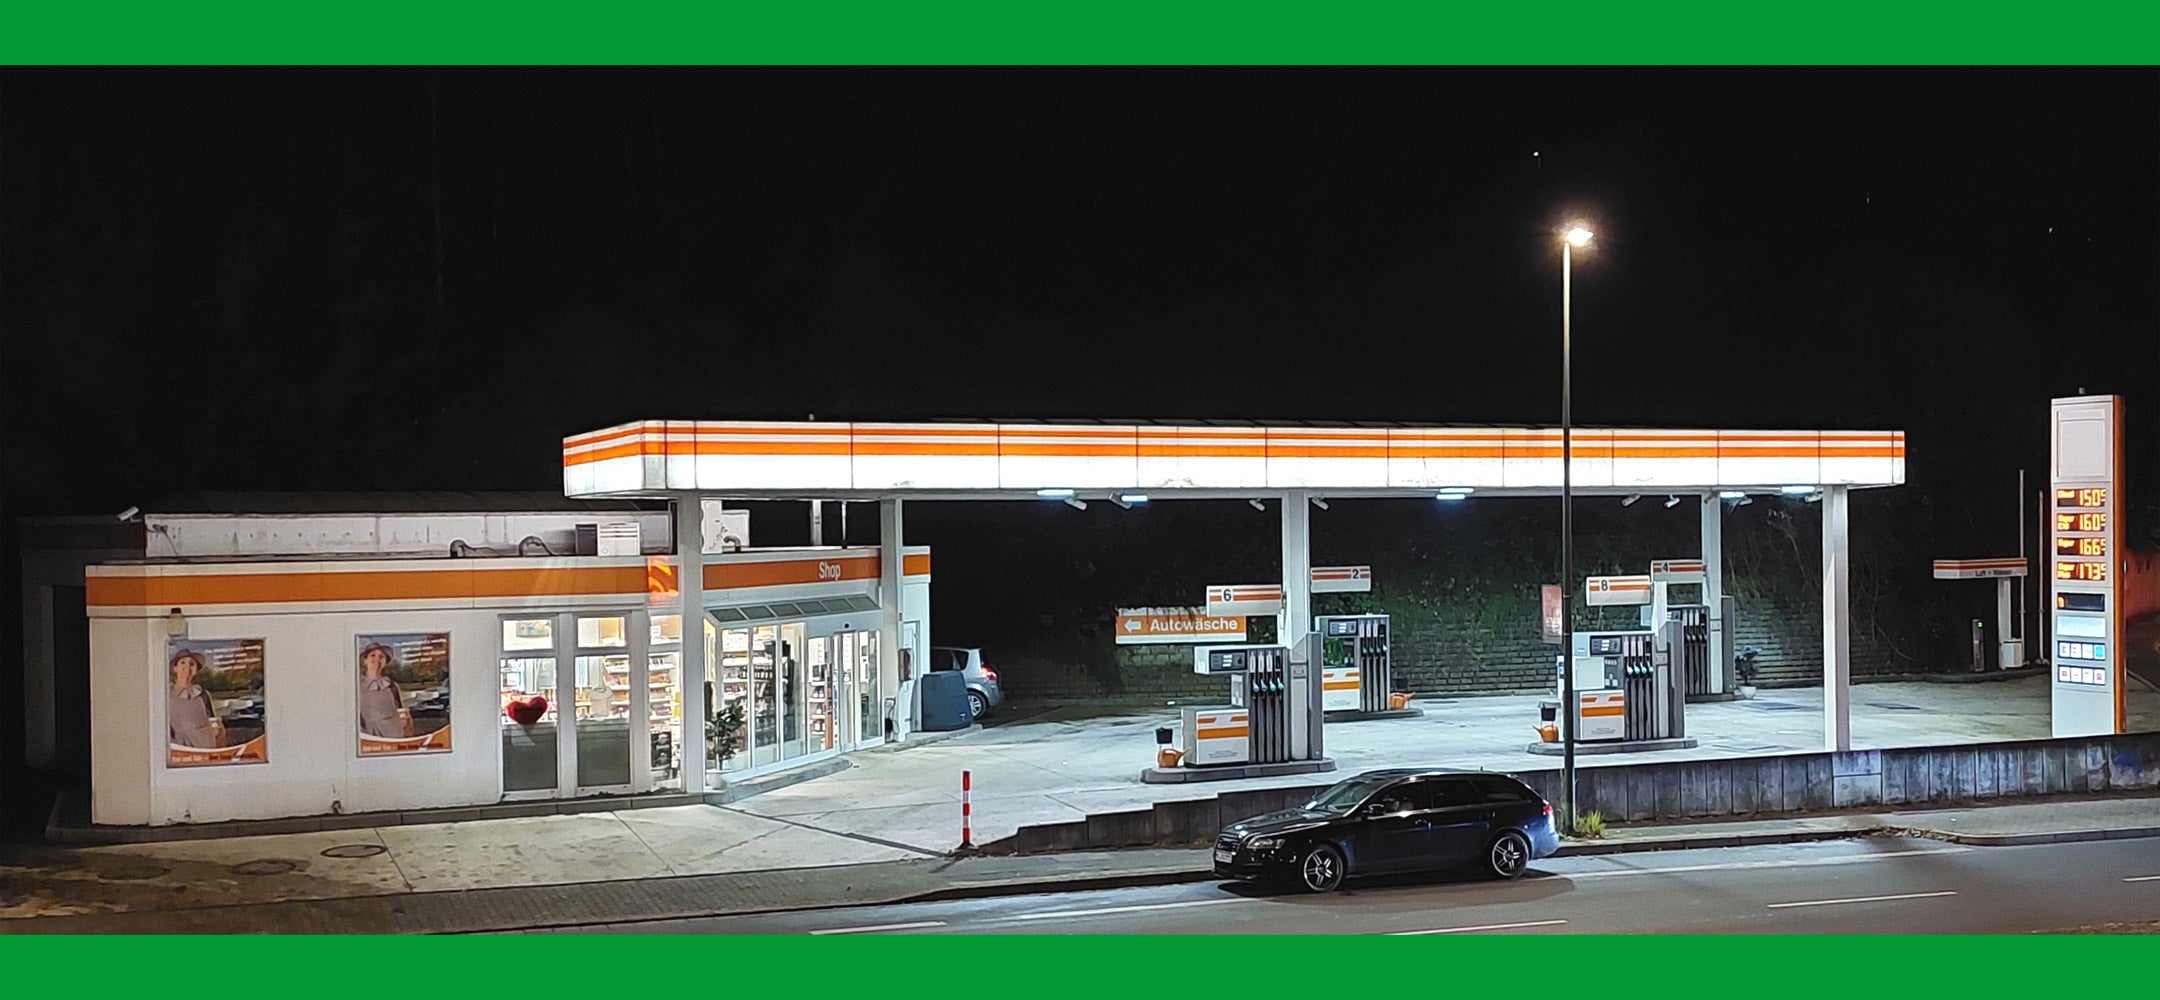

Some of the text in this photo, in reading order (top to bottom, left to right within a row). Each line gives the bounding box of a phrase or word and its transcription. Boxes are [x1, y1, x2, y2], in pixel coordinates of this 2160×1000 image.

[819, 561, 841, 581] Shop
[1663, 562, 1669, 572] 4
[1352, 568, 1359, 579] 2
[1601, 580, 1608, 592] 8
[1223, 588, 1232, 601] 6
[1149, 618, 1238, 632] Autowäsche
